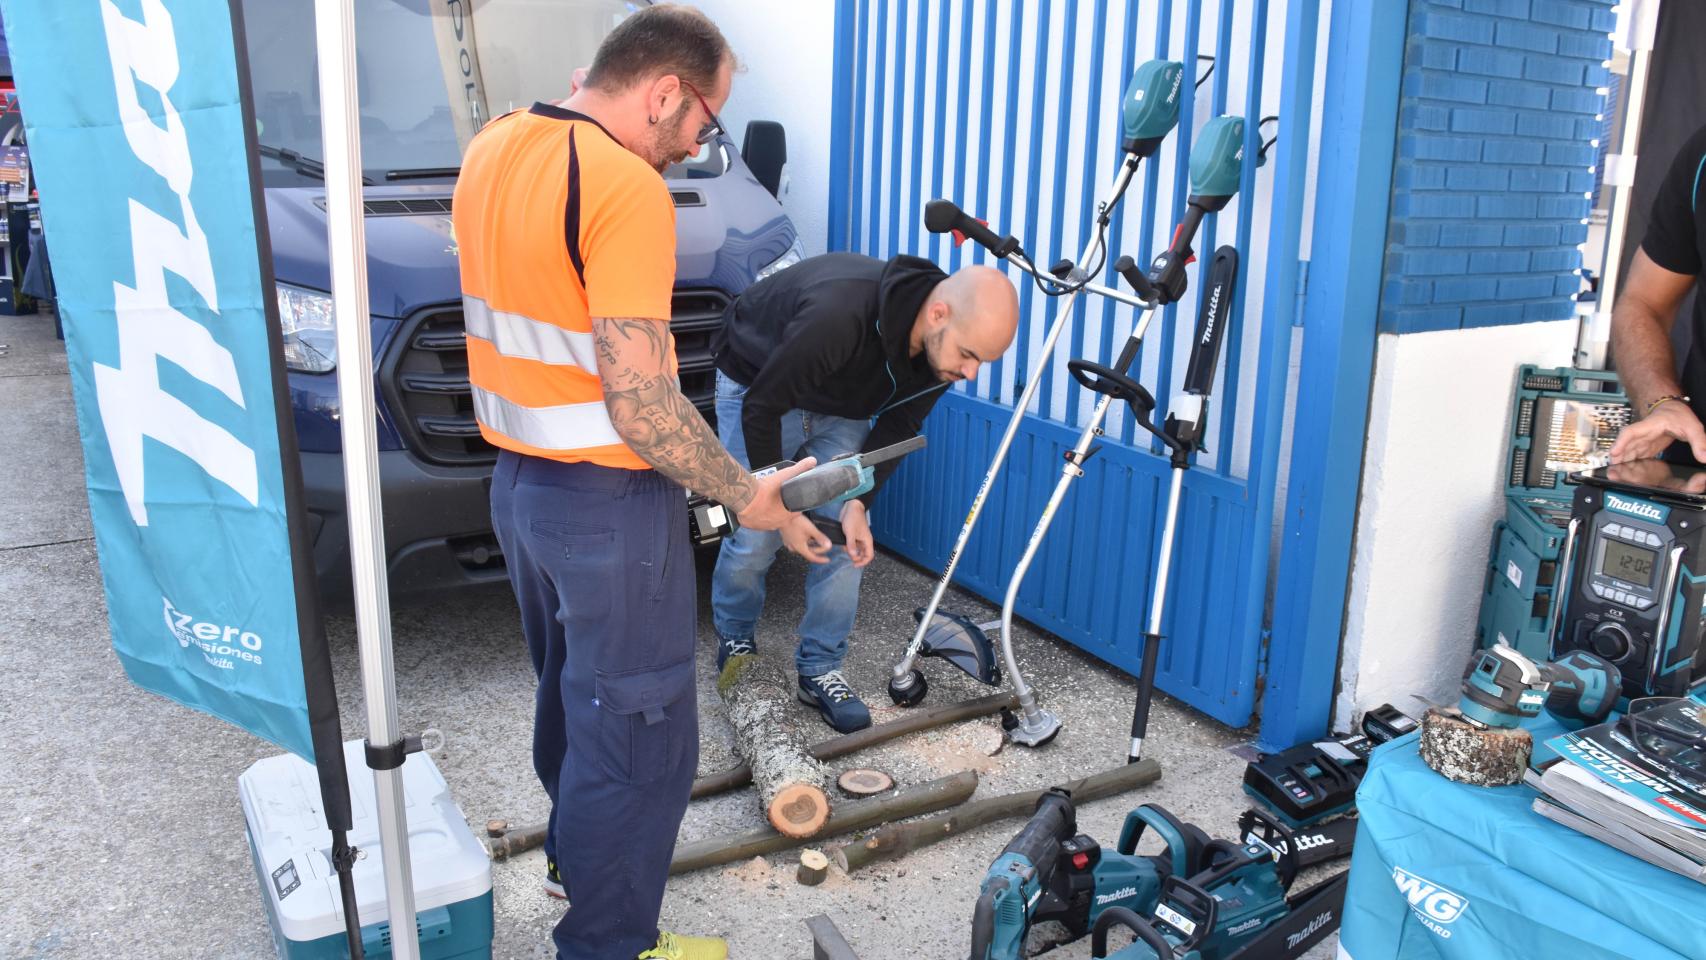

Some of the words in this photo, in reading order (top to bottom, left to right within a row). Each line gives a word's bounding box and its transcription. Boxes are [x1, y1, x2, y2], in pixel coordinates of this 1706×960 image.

[1201, 285, 1222, 346] Makita
[1607, 495, 1663, 521] Makita
[1619, 554, 1652, 575] 12:02
[1576, 739, 1674, 793] MEDIDA
[1588, 760, 1634, 784] KIT
[1095, 886, 1138, 905] Makita
[1227, 917, 1262, 937] Makita
[1286, 910, 1333, 950] Makita
